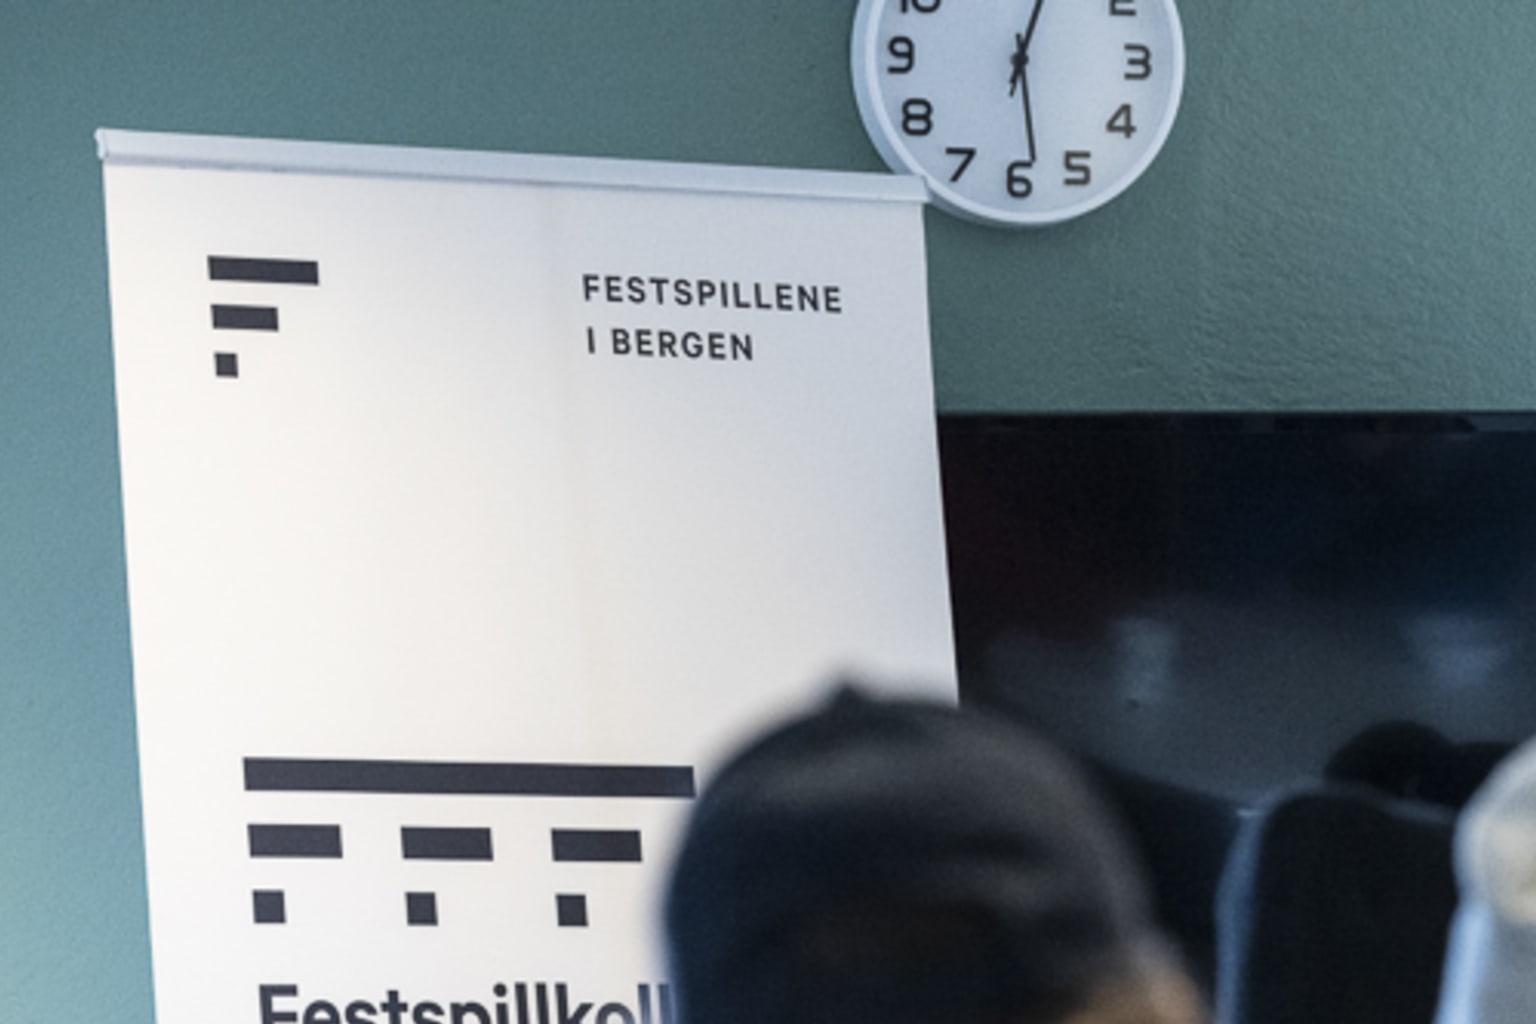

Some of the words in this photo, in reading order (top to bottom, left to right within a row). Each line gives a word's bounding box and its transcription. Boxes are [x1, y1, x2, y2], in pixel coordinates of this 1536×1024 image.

[886, 35, 915, 75] 9
[1123, 43, 1153, 81] 3
[901, 97, 934, 137] 8
[1105, 103, 1138, 139] 4
[945, 146, 977, 183] 7
[1005, 160, 1035, 199] 6
[1063, 150, 1092, 186] 5
[582, 273, 843, 314] FESTSPILLENE
[587, 326, 596, 354] I
[611, 327, 754, 361] BERGEN
